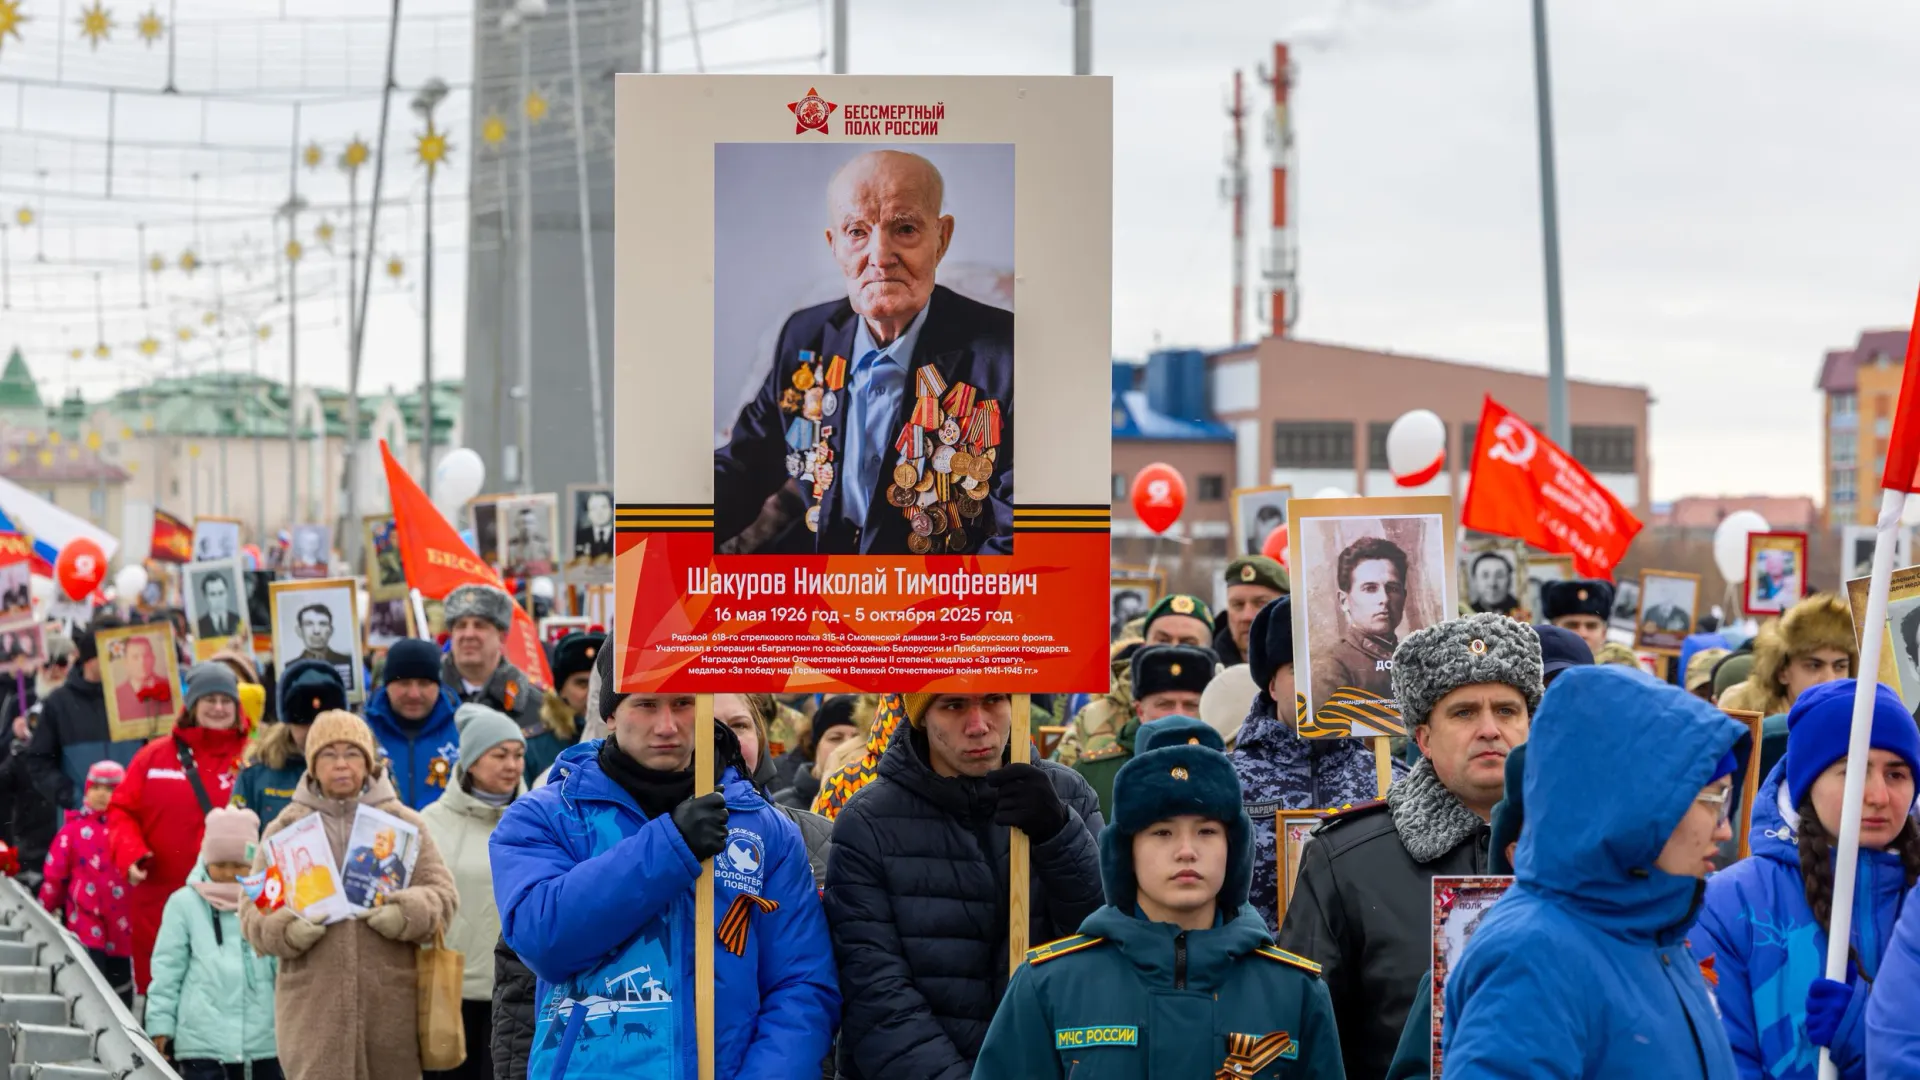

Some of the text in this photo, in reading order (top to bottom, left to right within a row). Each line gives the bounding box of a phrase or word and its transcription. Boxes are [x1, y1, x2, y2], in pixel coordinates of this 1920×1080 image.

[844, 102, 945, 119] БЕССМЕРТНЫЙ
[845, 121, 938, 135] ПОЛК РОССИИ
[687, 566, 1037, 601] Шакуров Николай Тимофеевич
[714, 607, 732, 622] 16
[736, 611, 766, 621] мая
[770, 607, 808, 622] 1926
[811, 610, 840, 624] год
[855, 607, 866, 622] 5
[869, 607, 936, 624] октября
[940, 607, 981, 622] 2025
[985, 611, 1014, 624] год
[671, 633, 1056, 642] Рядовой 618-го стрелкового полка 315-й Смоленской дивизии 3-го Белорусского фронта.
[655, 644, 1072, 653] Участвовал в операции «Багратион» по освобождению Белоруссии и Прибалтийских государств.
[700, 655, 1027, 664] Награжден Орденом Отечественной войны II степени, медалью «За отвагу»,
[687, 666, 727, 675] медалью
[727, 666, 743, 675] «За
[744, 666, 776, 675] победу
[776, 666, 794, 675] над
[794, 666, 842, 675] Германией
[842, 666, 849, 675] в
[849, 666, 887, 675] Великой
[887, 666, 955, 675] Отечественной
[955, 666, 983, 675] войне
[983, 666, 1023, 675] 1941-1945
[723, 879, 760, 896] ПОБЕДЫ
[1459, 902, 1483, 910] ПОЛК
[1058, 1027, 1135, 1046] МЧС РОССИИ
